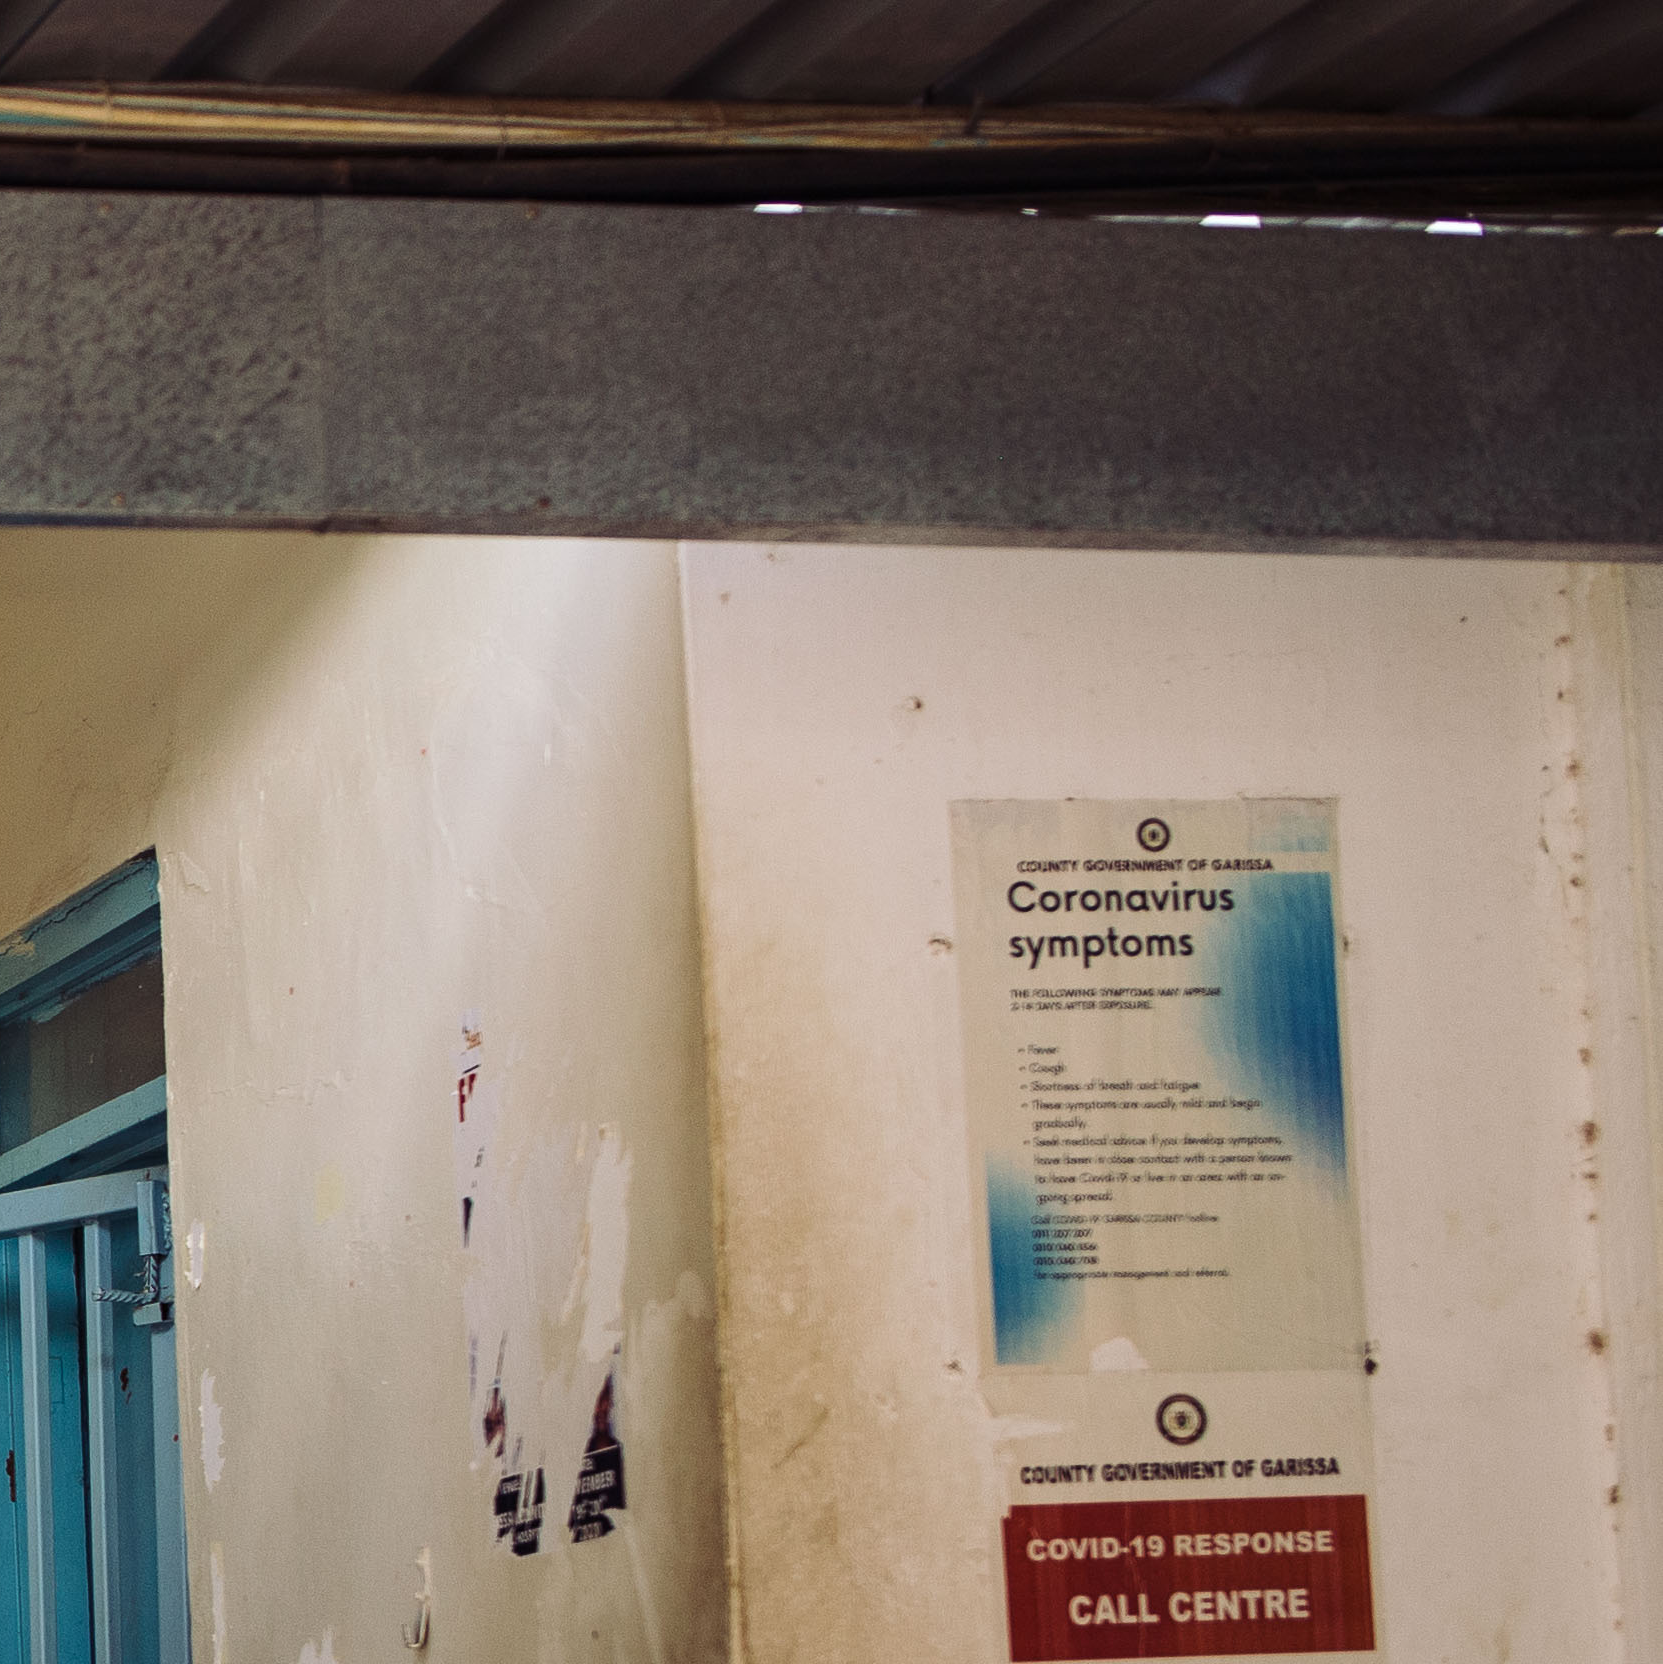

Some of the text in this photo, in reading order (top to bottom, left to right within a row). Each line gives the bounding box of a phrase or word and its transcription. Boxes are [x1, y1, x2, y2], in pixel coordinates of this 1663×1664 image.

[1017, 859, 1273, 872] COUNTY GOVERNMENT OF GARISSA
[1007, 881, 1235, 912] Coronavirus
[1009, 927, 1194, 969] symptoms
[1020, 1458, 1340, 1483] COUNTY GOVERNMENT OF GARISSA
[1026, 1531, 1334, 1560] COVID-19 RESPONSE
[1069, 1589, 1309, 1624] CALL CENTRE
